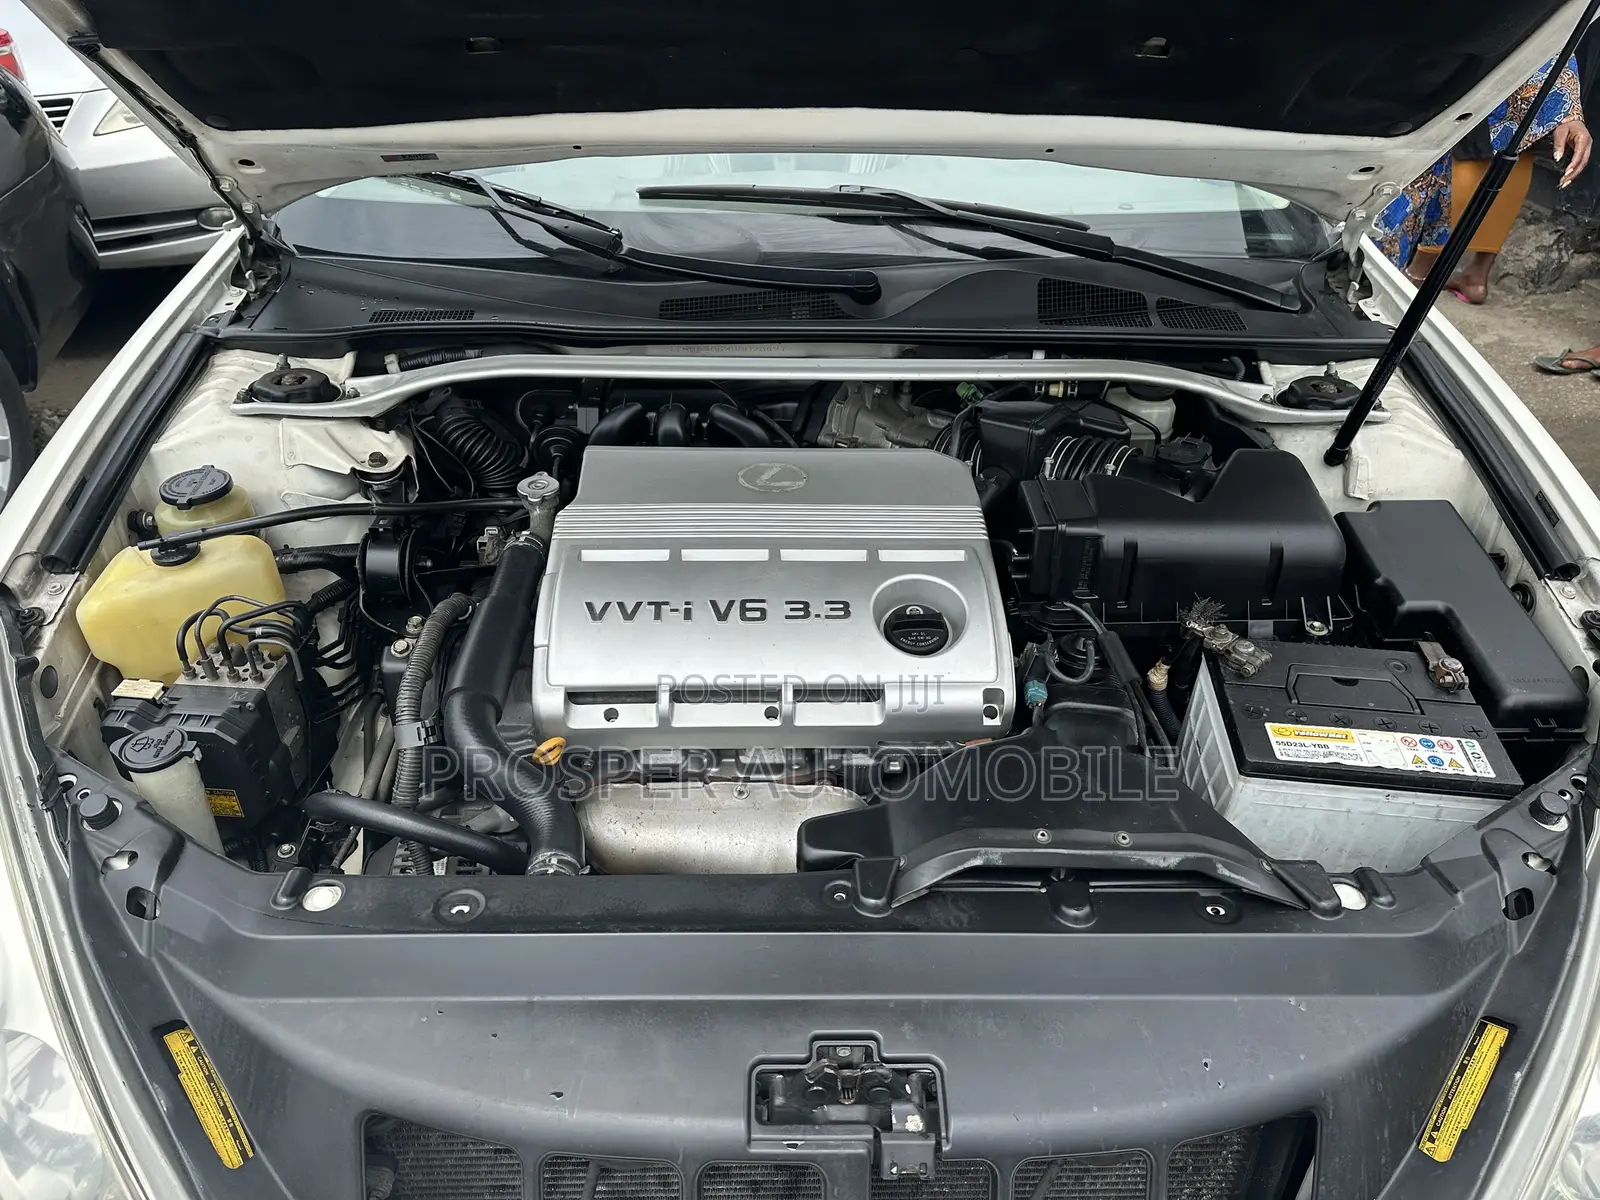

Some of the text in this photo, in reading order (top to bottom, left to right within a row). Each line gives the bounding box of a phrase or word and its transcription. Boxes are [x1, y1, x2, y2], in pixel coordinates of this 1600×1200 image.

[584, 598, 852, 624] VVT-i V6 3.3
[900, 636, 939, 647] ENERGY CONSERVING
[197, 1056, 224, 1107] CAUTION ATTENTION
[1436, 1075, 1461, 1127] CAUTION ATTENTION
